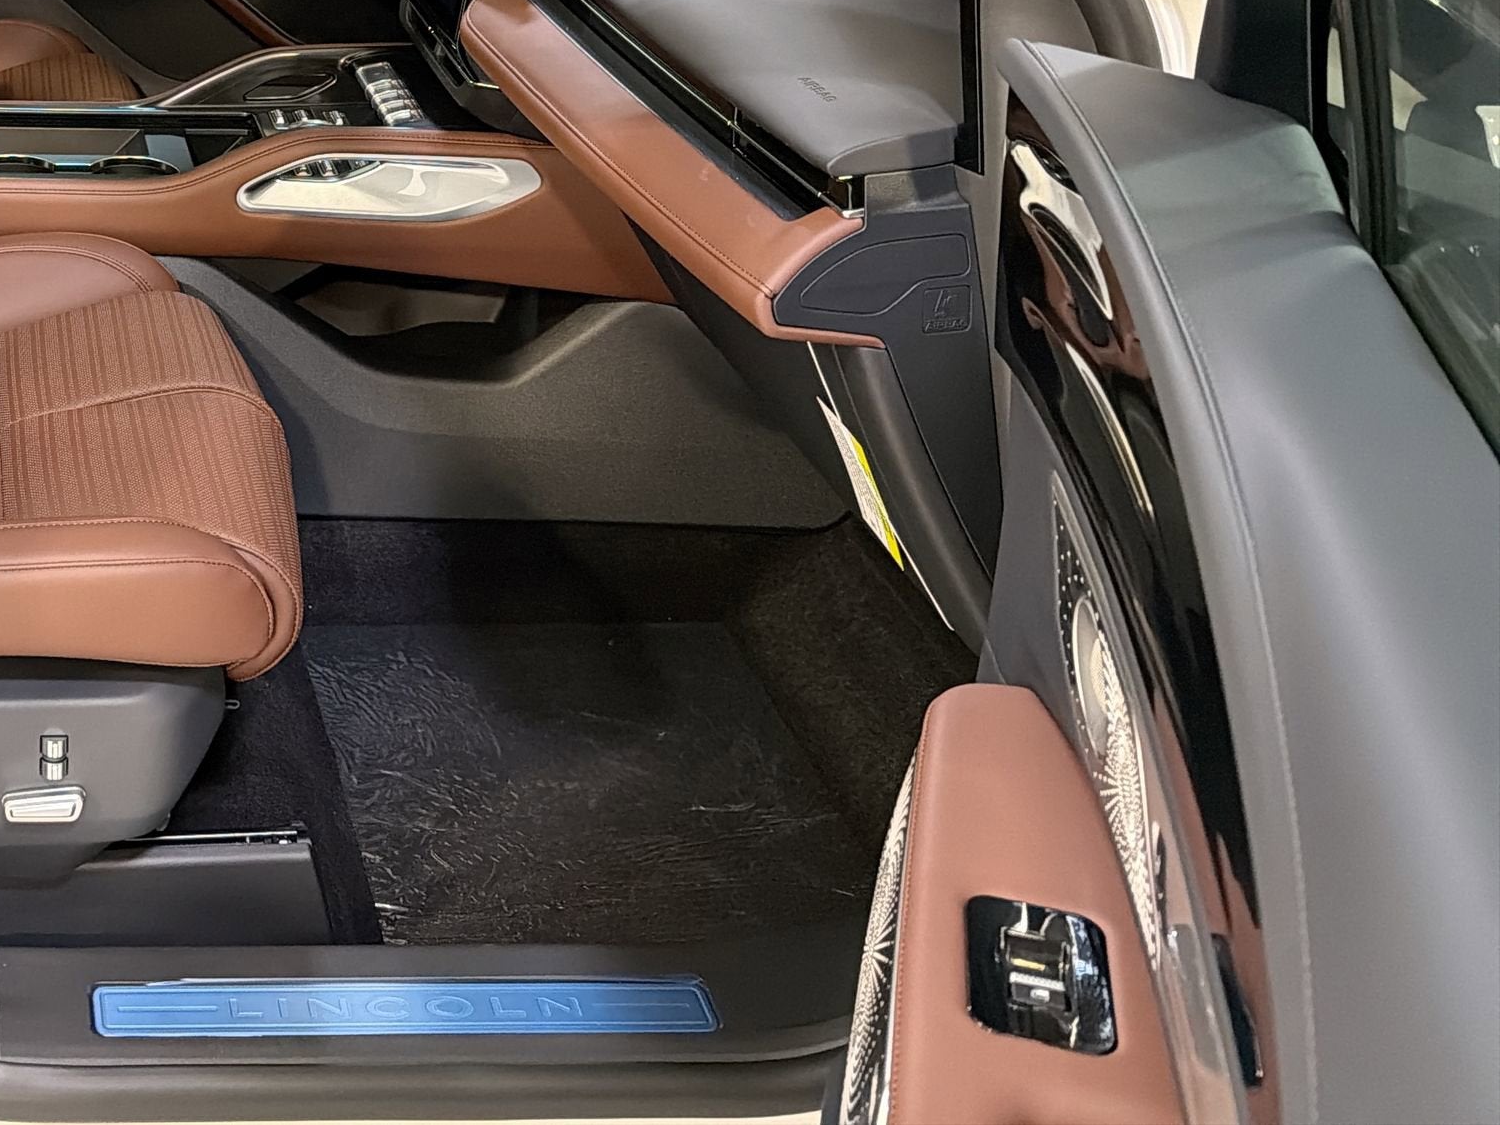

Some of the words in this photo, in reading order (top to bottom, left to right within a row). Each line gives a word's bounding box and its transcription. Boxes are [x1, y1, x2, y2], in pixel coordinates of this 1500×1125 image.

[797, 77, 837, 103] AIRBAG
[924, 319, 968, 332] AIRBAG
[228, 995, 584, 1019] LINCOLN
